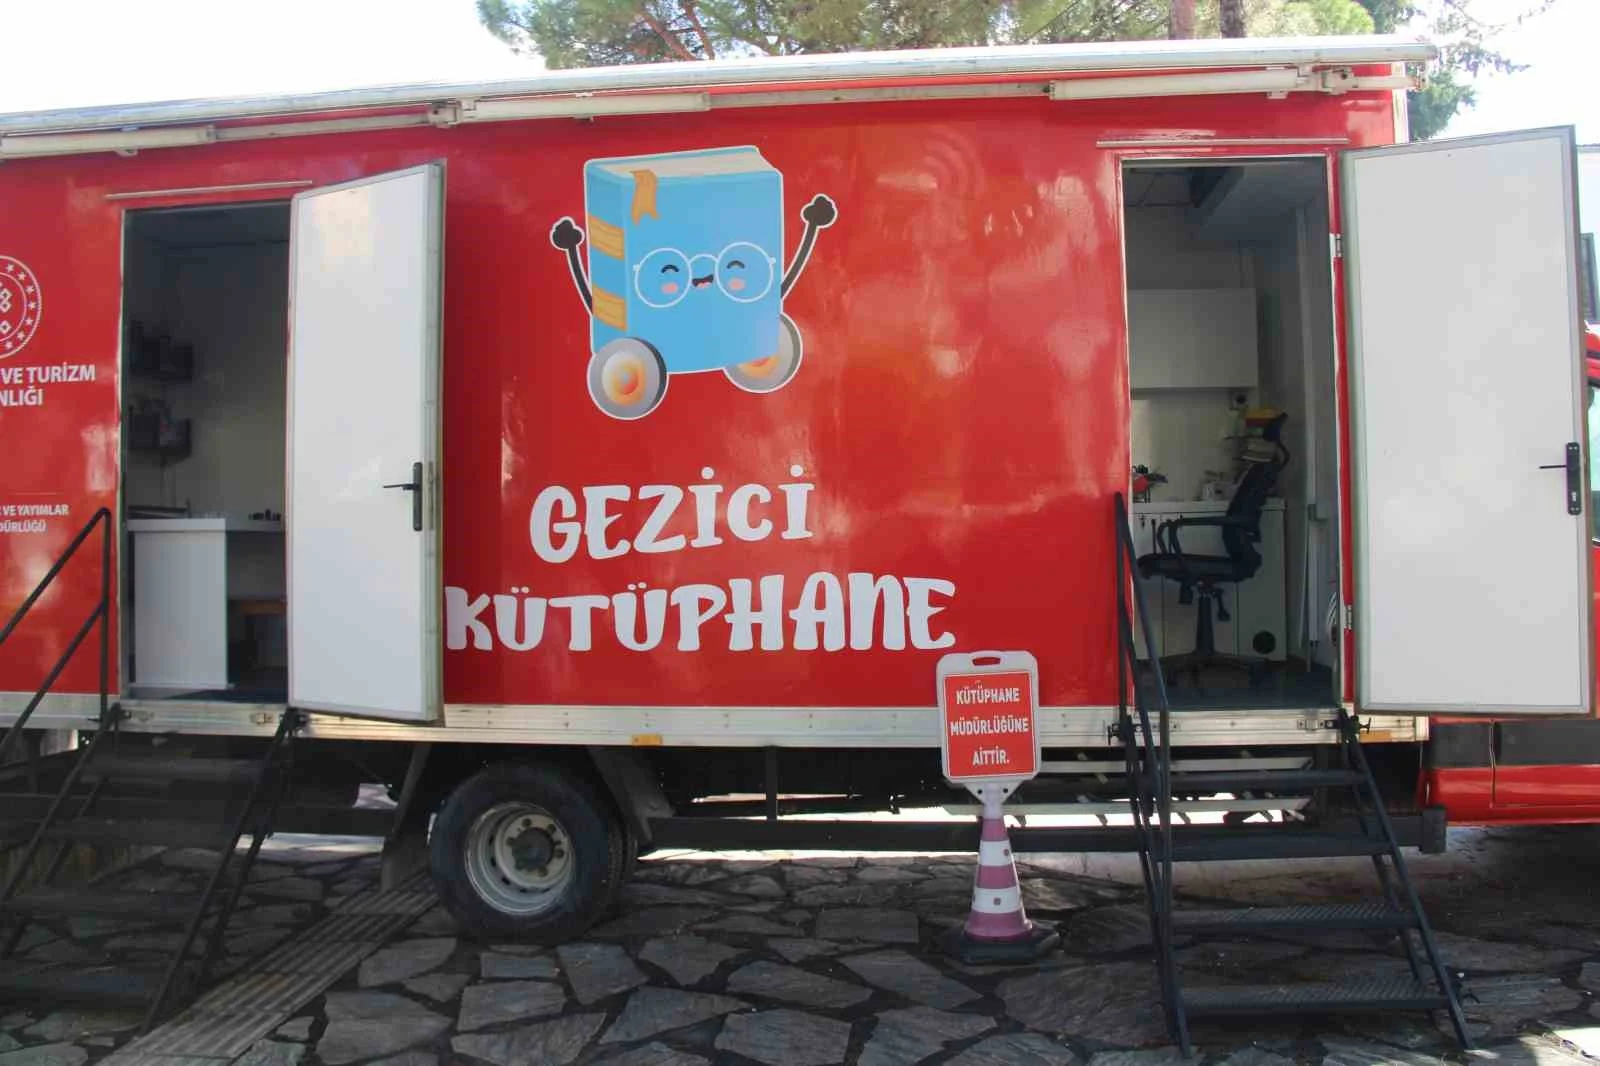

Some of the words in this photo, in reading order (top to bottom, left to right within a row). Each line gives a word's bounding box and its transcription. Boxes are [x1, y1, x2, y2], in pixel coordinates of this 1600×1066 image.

[0, 367, 24, 384] VE
[26, 362, 96, 383] TURİZM
[3, 504, 17, 516] VE
[17, 503, 69, 516] YAYIMLAR
[529, 465, 815, 563] GEZİCİ
[444, 571, 956, 652] KÜTÜPHANE
[956, 684, 1020, 705] KÜTÜPHANE
[950, 714, 1029, 736] MÜDÜRLÜĞÜNE
[972, 745, 1010, 766] AİTTİR.
